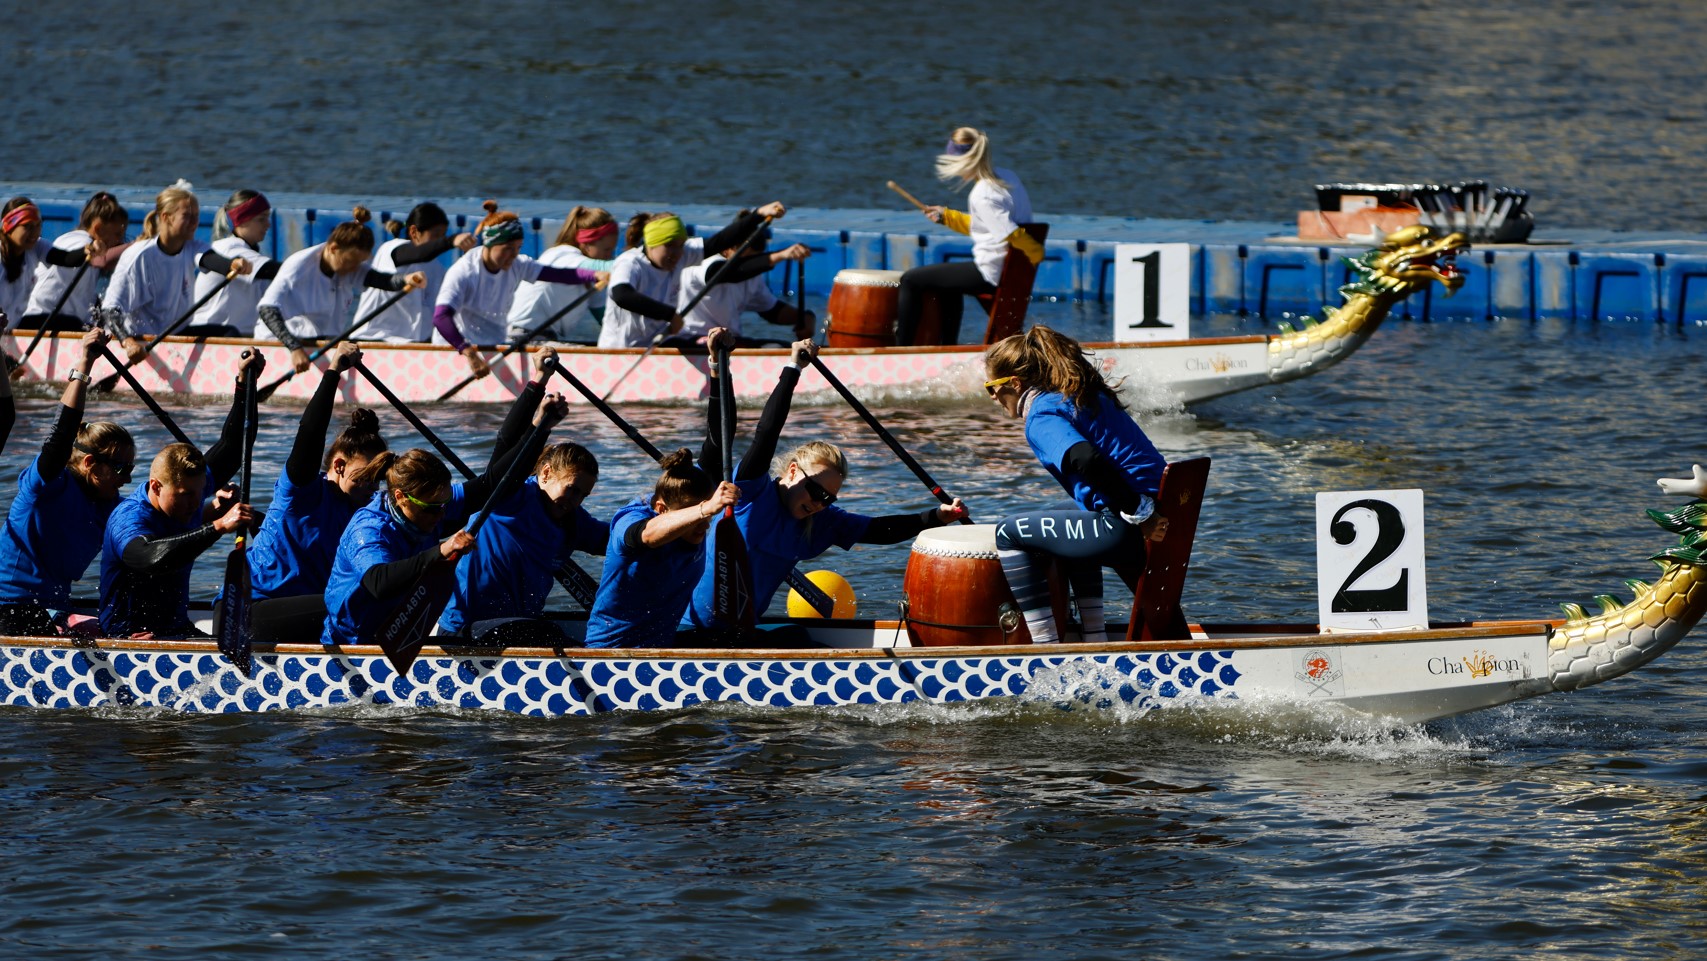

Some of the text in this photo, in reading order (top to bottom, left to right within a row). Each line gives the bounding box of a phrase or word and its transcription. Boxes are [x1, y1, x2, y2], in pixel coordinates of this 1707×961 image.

[1129, 251, 1175, 329] 1
[718, 551, 729, 614] НОРД-АВТО
[1330, 498, 1408, 613] 2
[384, 585, 427, 641] НОРД-АВТО
